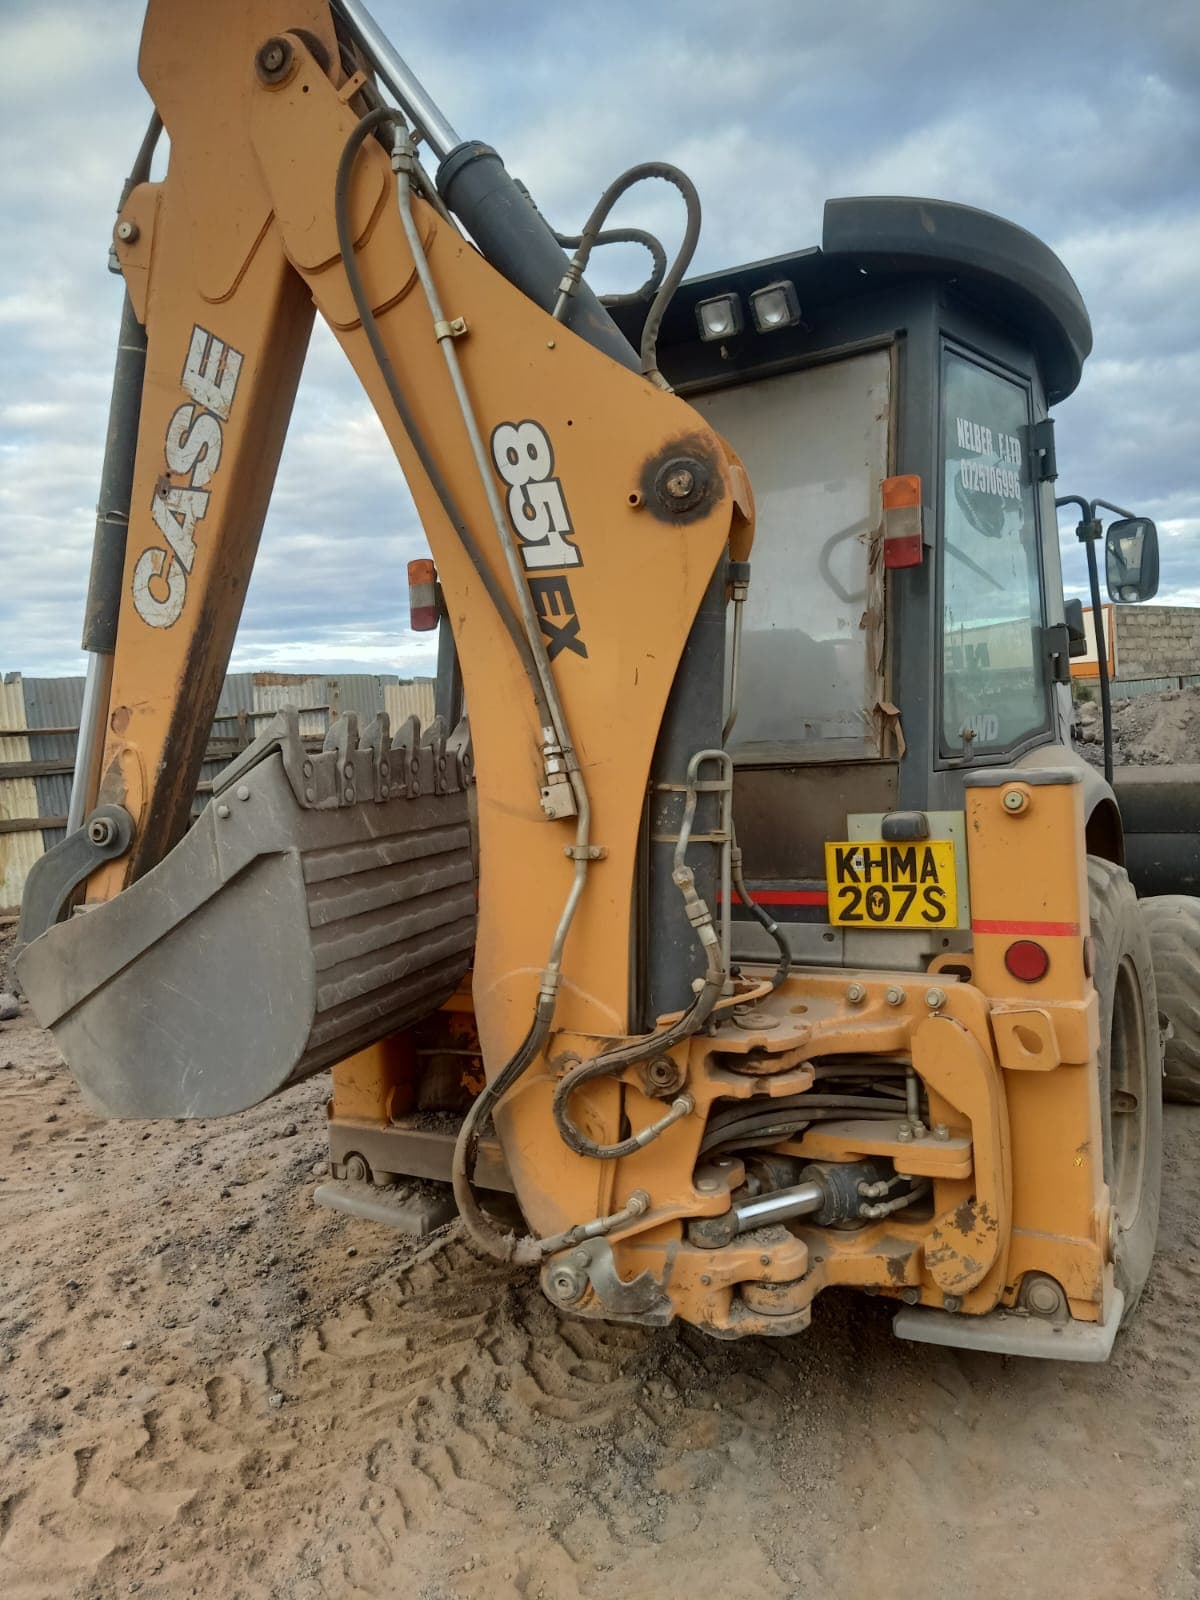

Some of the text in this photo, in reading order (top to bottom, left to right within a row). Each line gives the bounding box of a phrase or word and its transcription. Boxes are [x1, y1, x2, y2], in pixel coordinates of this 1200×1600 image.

[132, 324, 244, 629] CASE
[490, 419, 589, 663] 851 EX
[835, 846, 940, 884] KHMA
[838, 885, 946, 923] 207S
